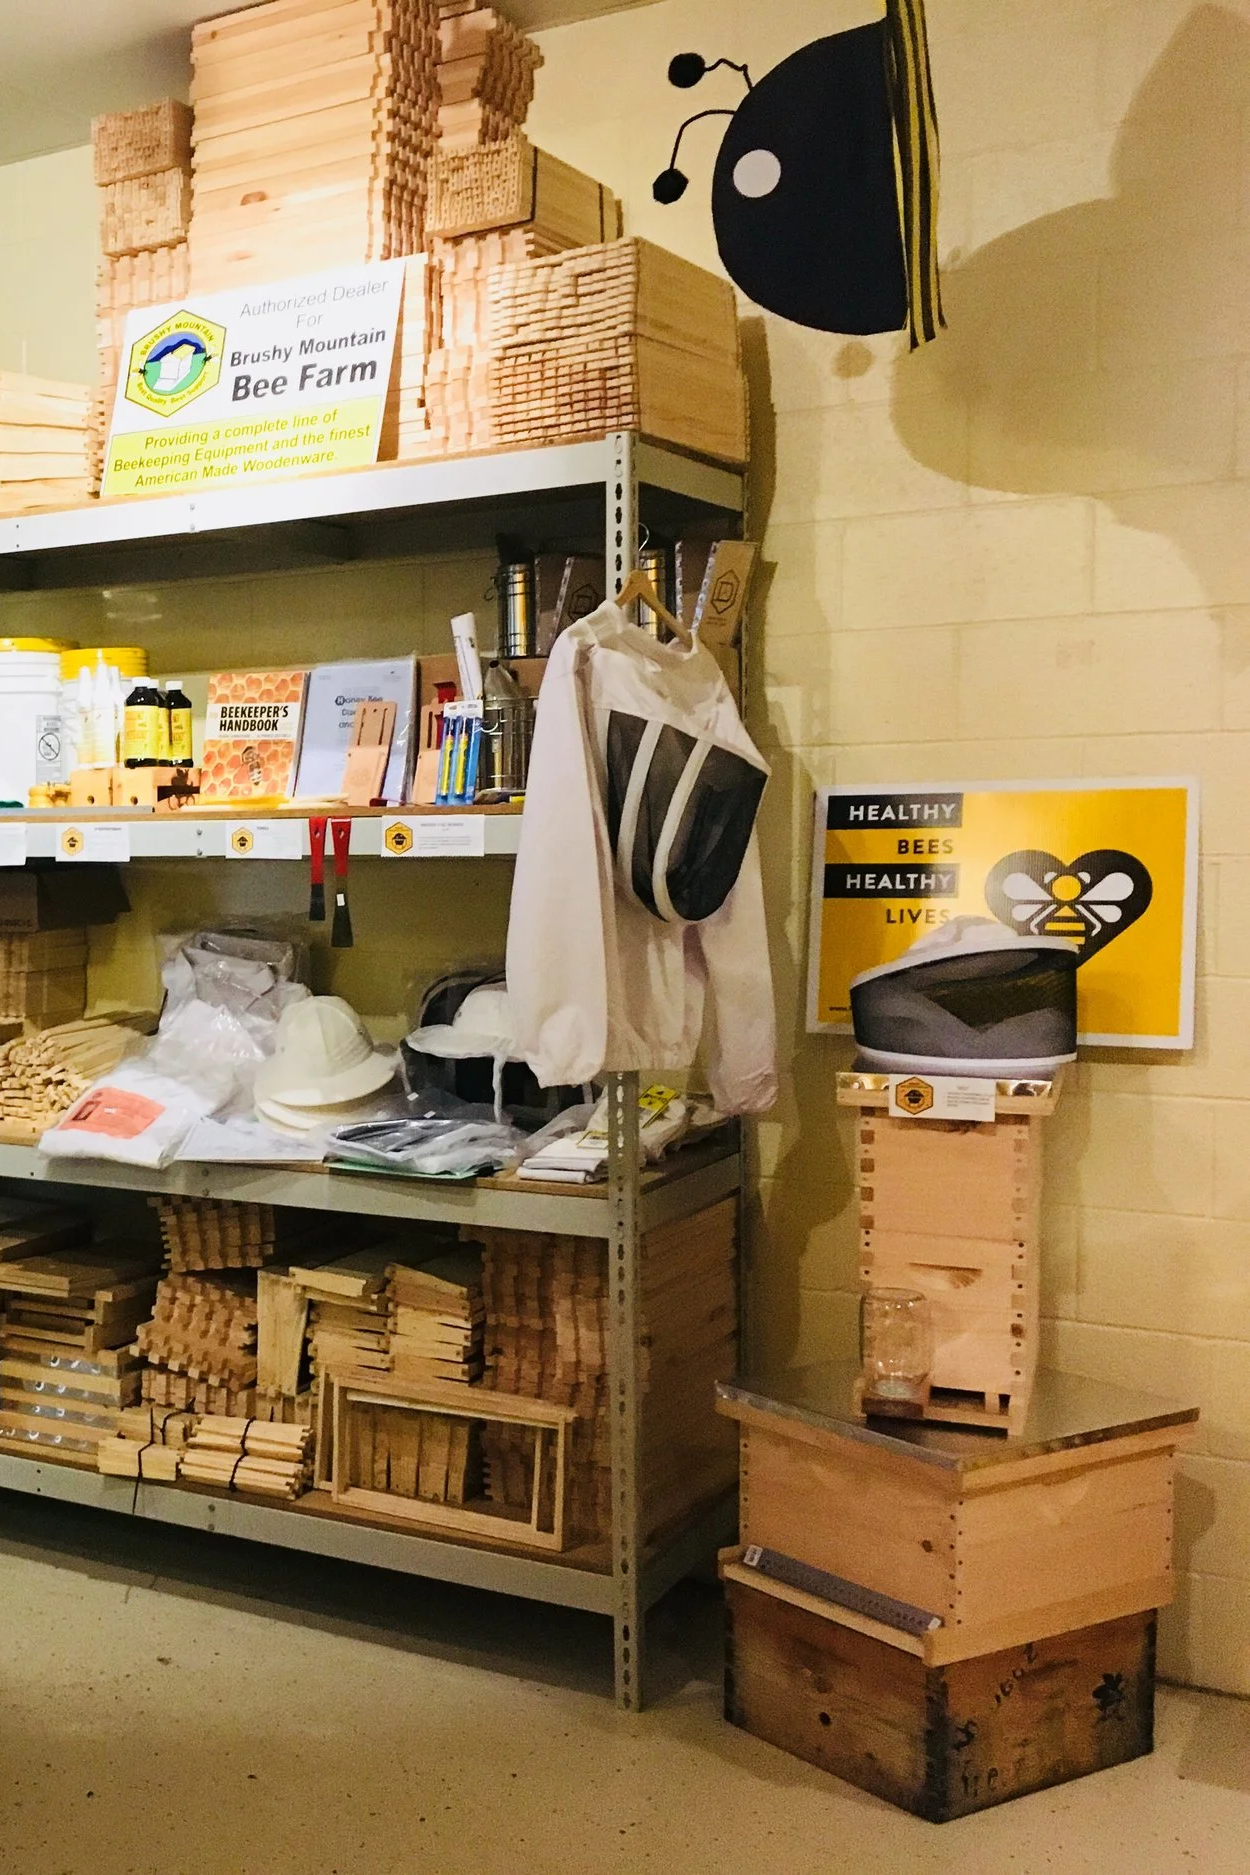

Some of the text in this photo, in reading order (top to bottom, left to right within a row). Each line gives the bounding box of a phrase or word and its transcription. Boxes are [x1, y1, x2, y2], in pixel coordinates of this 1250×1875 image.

[240, 279, 389, 319] Authorized Dealer
[296, 311, 323, 329] For
[140, 321, 215, 356] BRUSHY MOUNTAIN
[230, 328, 386, 367] Brushy Mountain
[232, 360, 377, 402] Bee Farm
[144, 409, 338, 451] Providing a complete line of
[113, 424, 371, 473] Beekeeping Equipment and the finest
[135, 450, 337, 488] American Made Woodenware.
[220, 705, 289, 718] BEEKEEPER'S
[219, 719, 279, 731] HANDBOOK
[849, 803, 956, 821] HEALTHY
[898, 839, 954, 855] BEES
[846, 873, 952, 889] HEALTHY
[886, 908, 950, 924] LIVES
